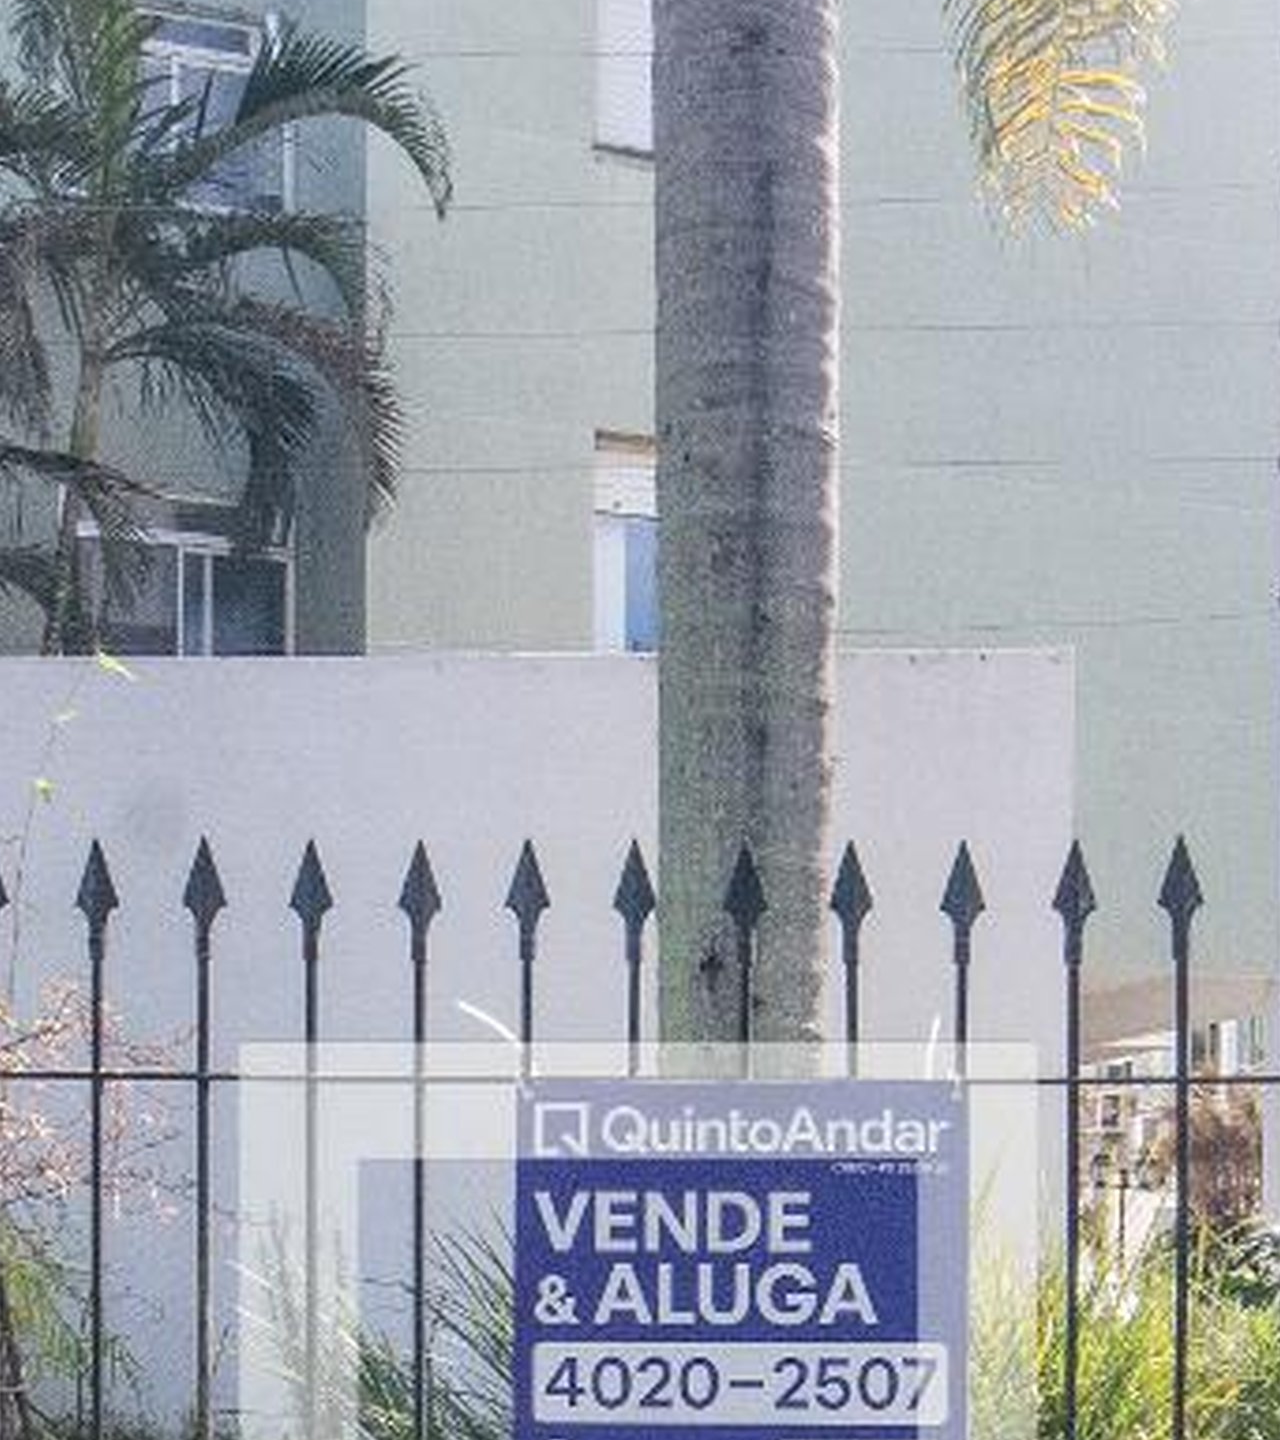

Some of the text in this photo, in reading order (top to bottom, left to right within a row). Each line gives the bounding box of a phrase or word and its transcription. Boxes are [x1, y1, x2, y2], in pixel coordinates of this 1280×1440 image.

[601, 1105, 951, 1155] QuintoAndar
[534, 1191, 812, 1253] VENDE
[534, 1262, 880, 1326] & ALUGA
[545, 1356, 938, 1411] 4020-2507
